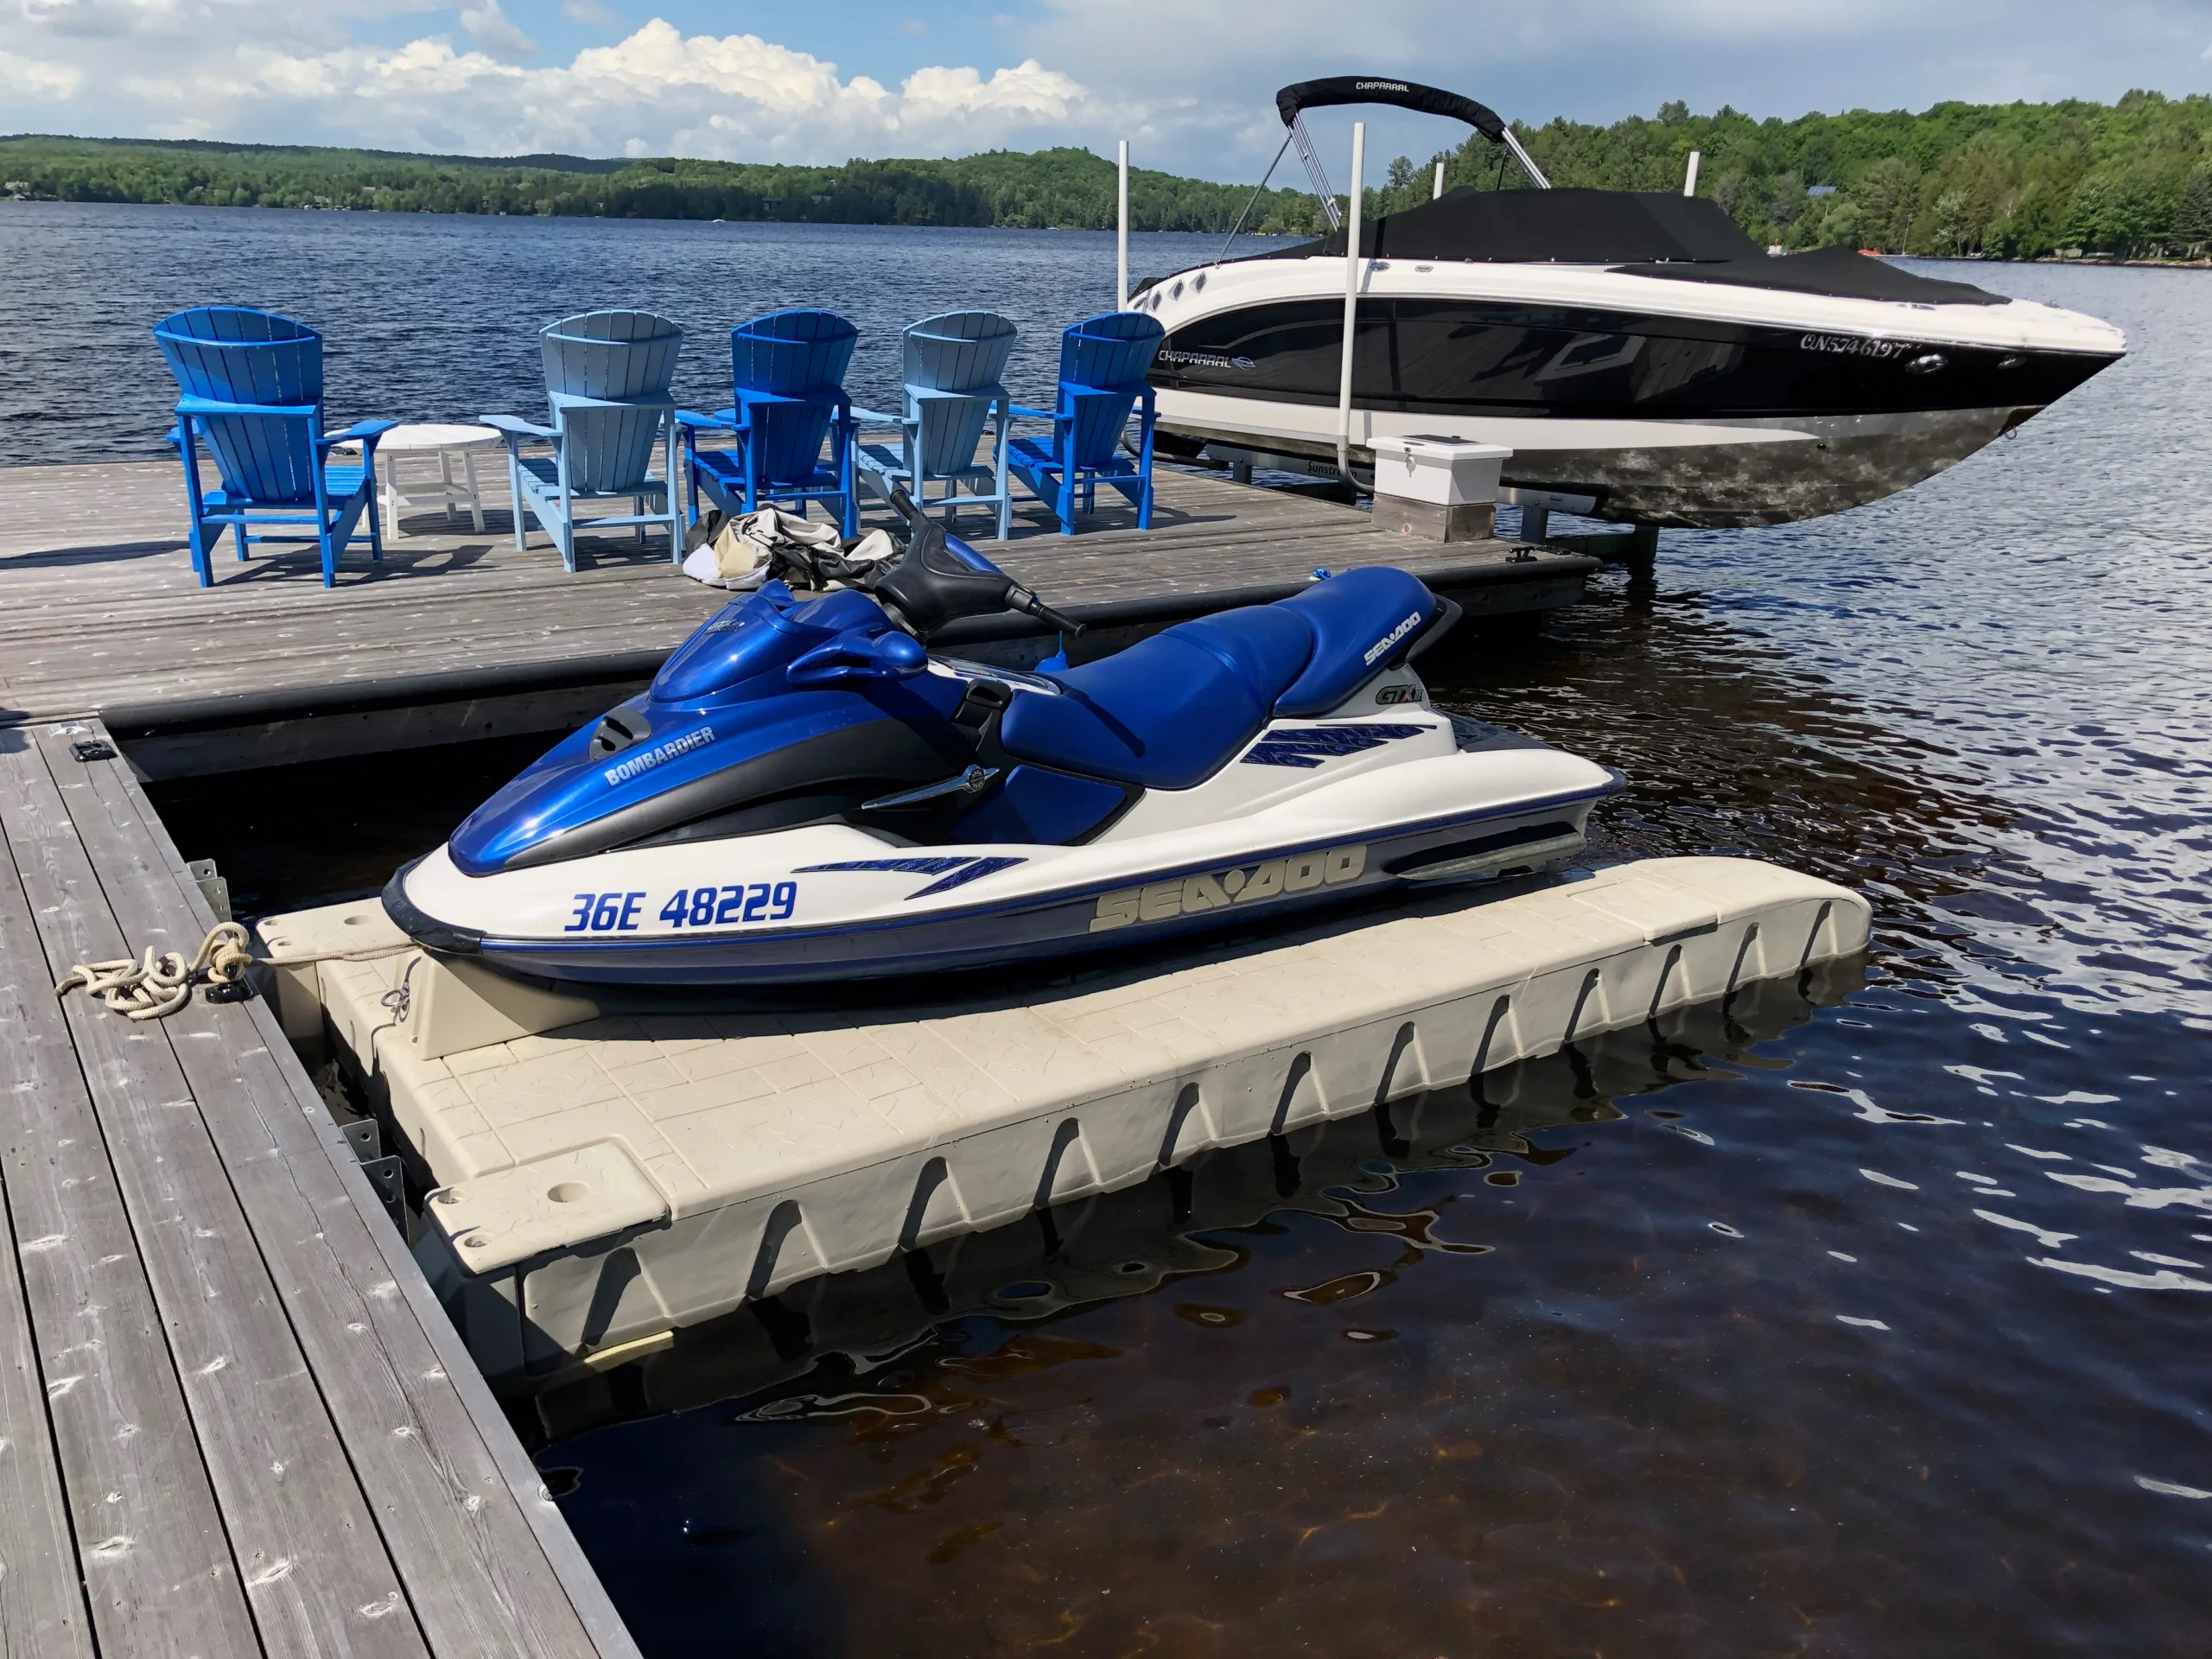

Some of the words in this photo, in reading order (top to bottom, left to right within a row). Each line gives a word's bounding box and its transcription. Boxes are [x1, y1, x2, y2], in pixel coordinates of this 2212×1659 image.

[1356, 81, 1409, 92] CHAPARRAL
[1158, 350, 1231, 368] CHAPARRAL
[1307, 461, 1357, 479] Sunstrem
[605, 726, 716, 786] BOMBARDIER
[563, 892, 646, 931] 36E
[659, 881, 798, 928] 48229
